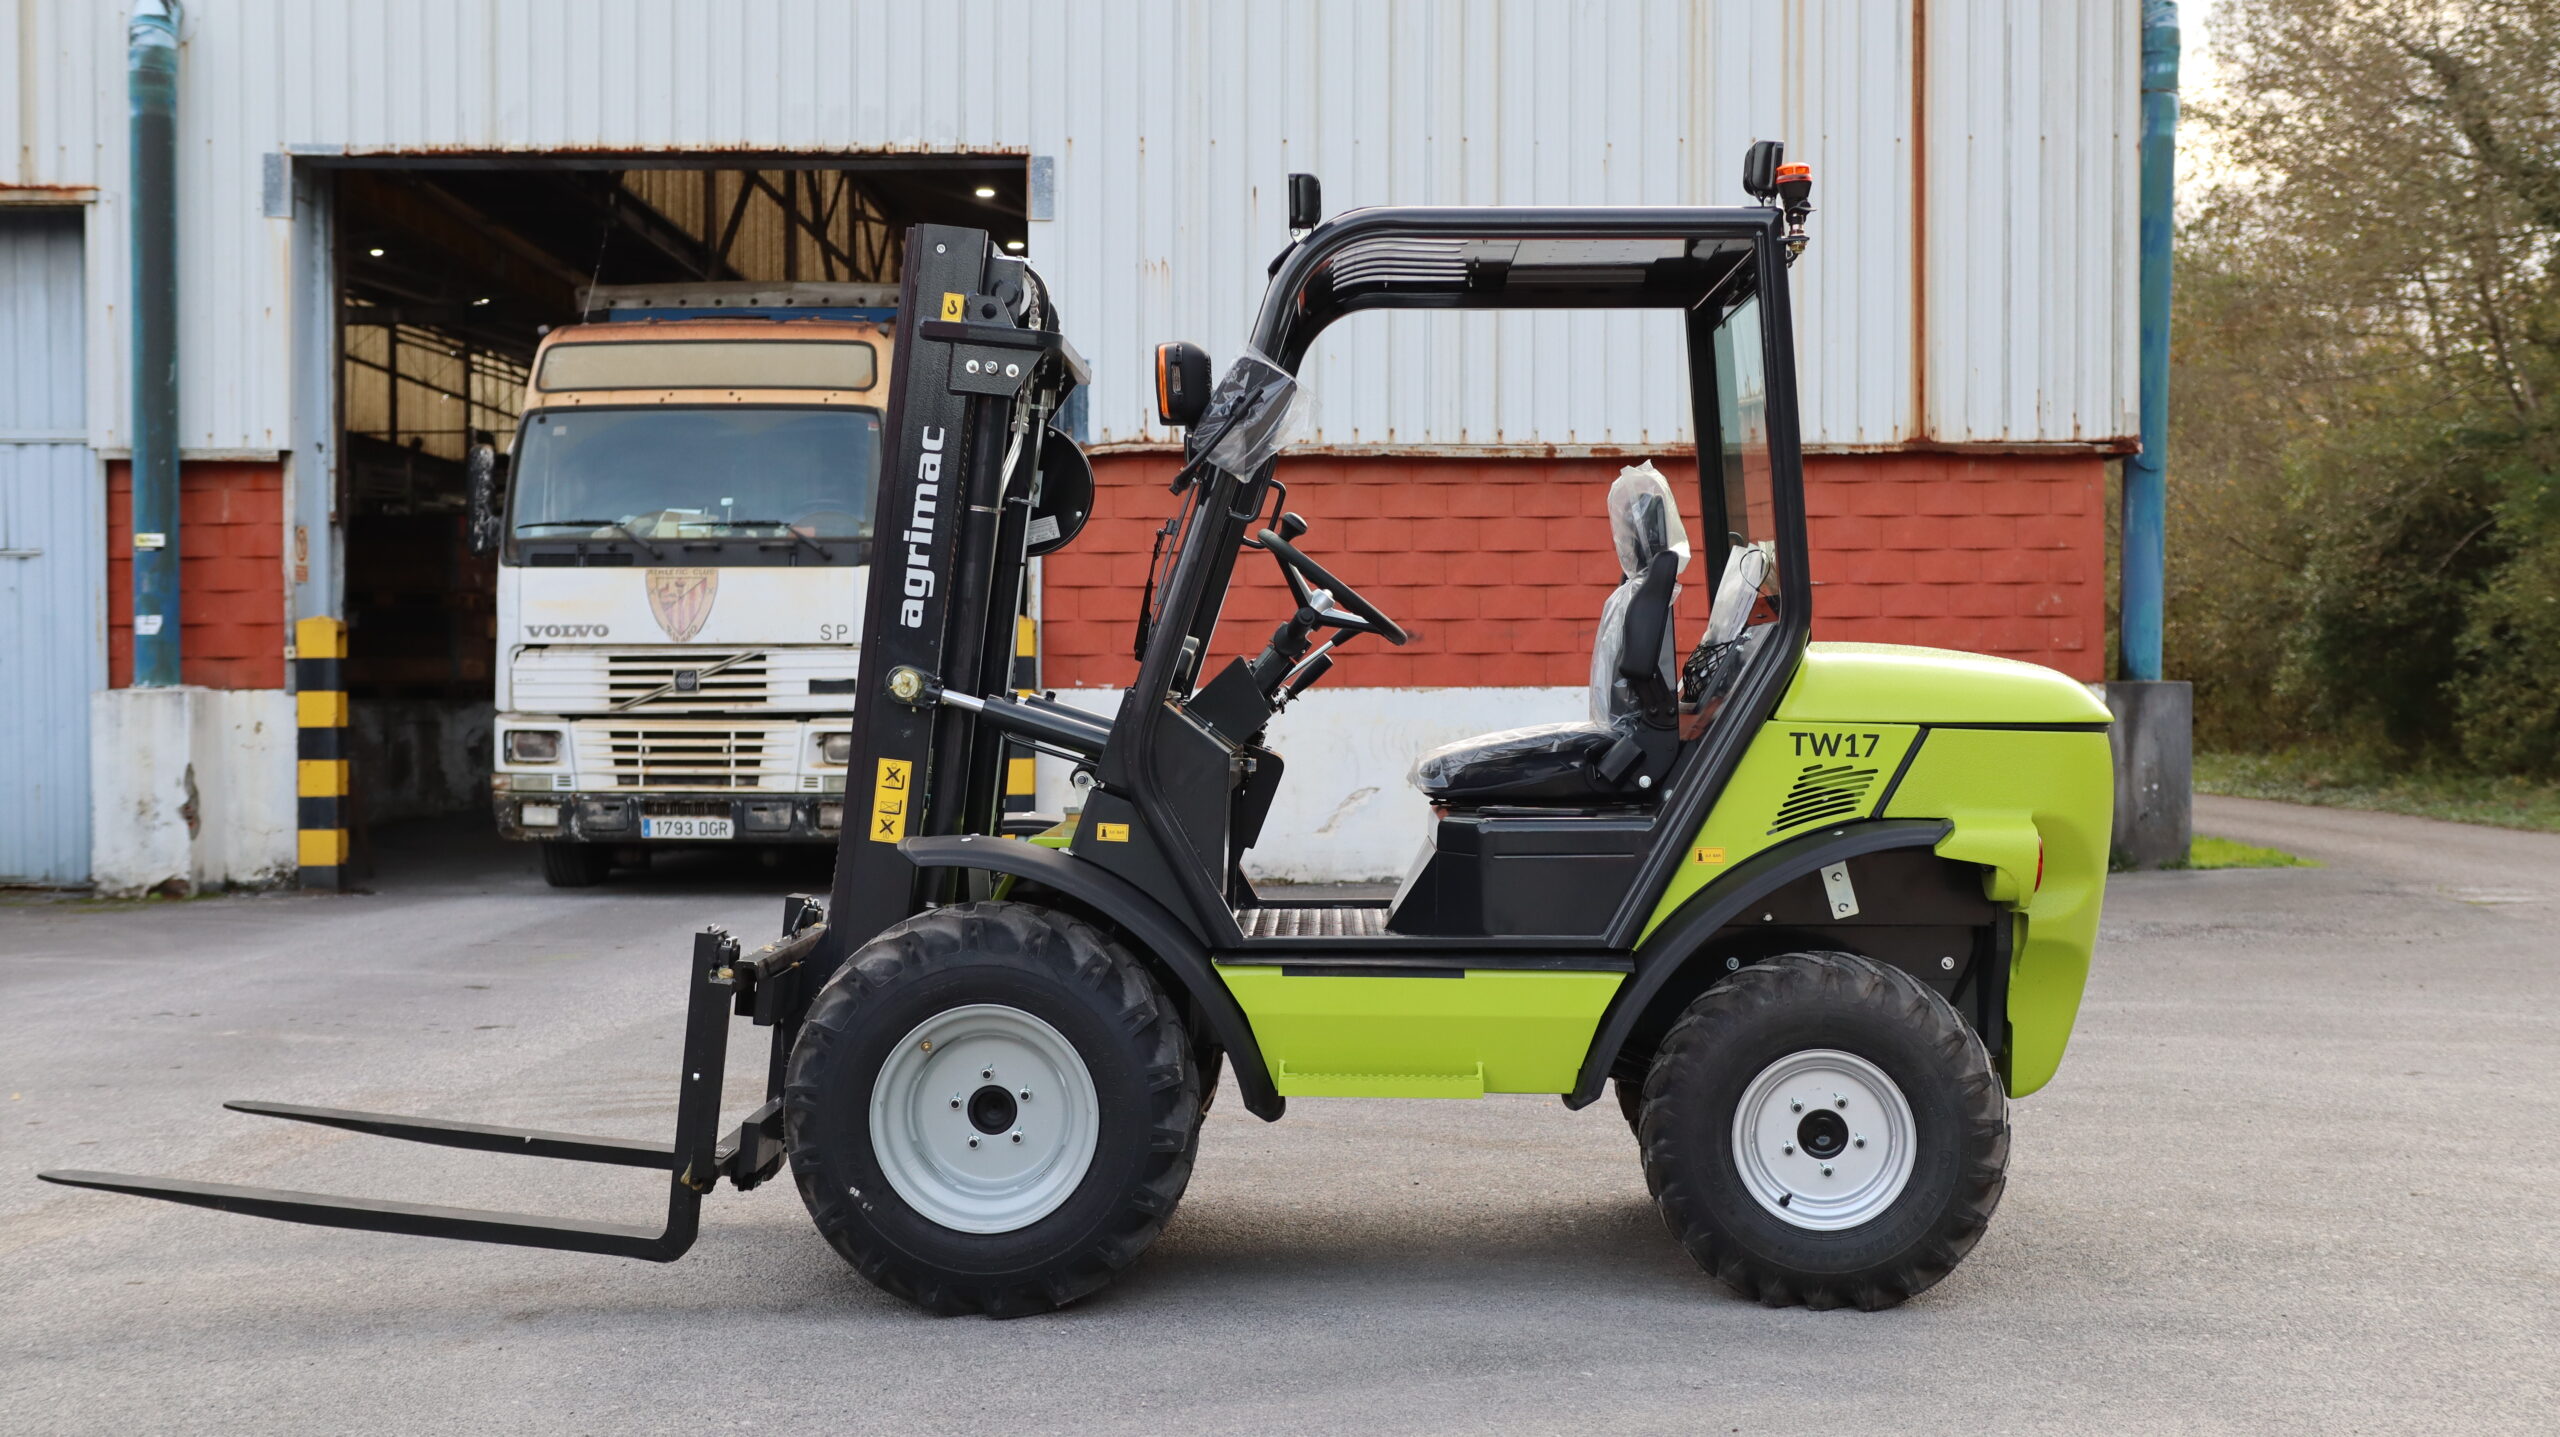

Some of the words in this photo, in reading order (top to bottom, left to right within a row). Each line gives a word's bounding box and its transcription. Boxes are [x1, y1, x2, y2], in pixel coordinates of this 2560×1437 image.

[900, 425, 945, 629] agrimac
[524, 624, 609, 638] VOLVO
[820, 624, 848, 641] SP
[1789, 732, 1880, 758] TW17
[656, 821, 693, 836] 1793
[699, 821, 728, 836] DGR
